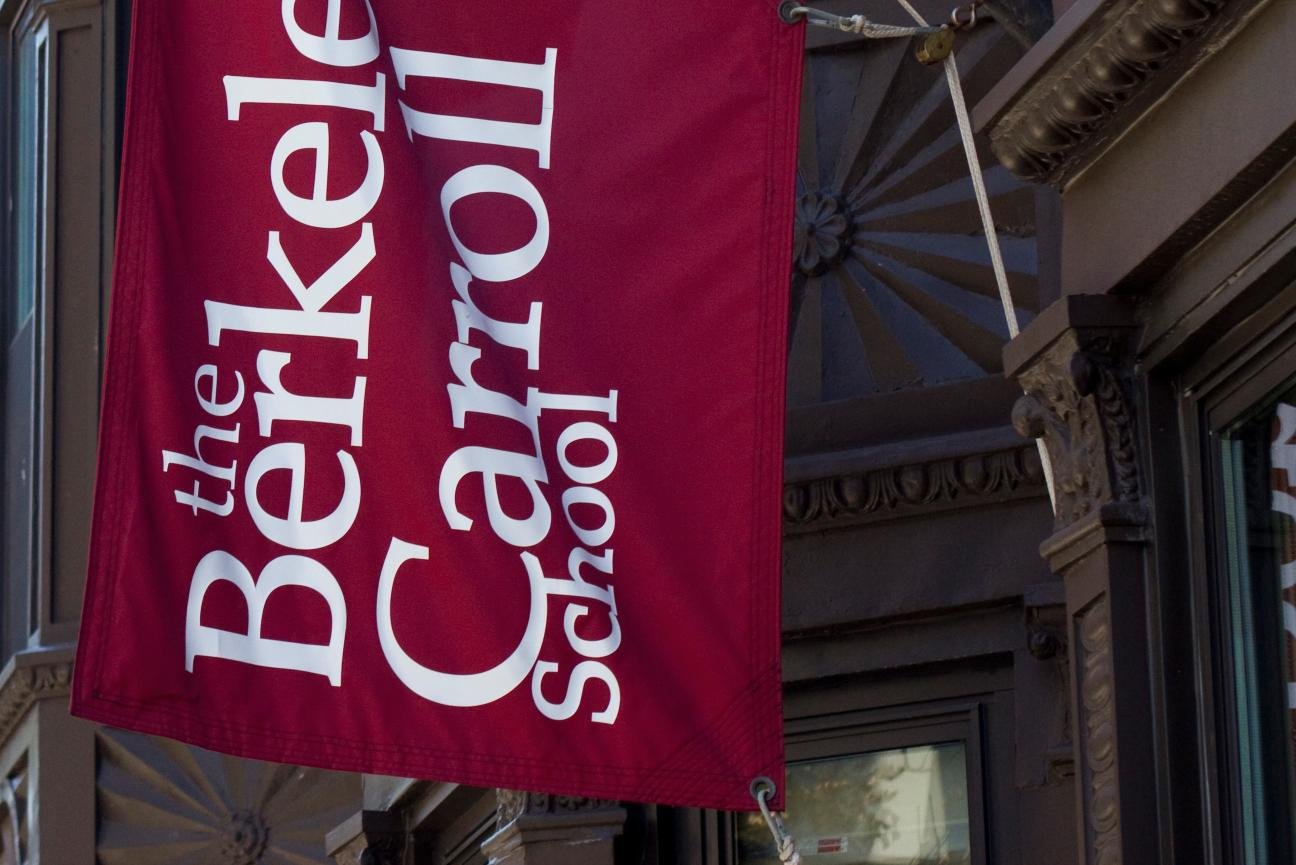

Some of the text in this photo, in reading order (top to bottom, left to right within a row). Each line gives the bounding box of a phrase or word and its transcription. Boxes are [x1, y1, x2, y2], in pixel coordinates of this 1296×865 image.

[162, 365, 245, 517] the
[377, 47, 558, 707] Carroll
[523, 387, 622, 725] School
